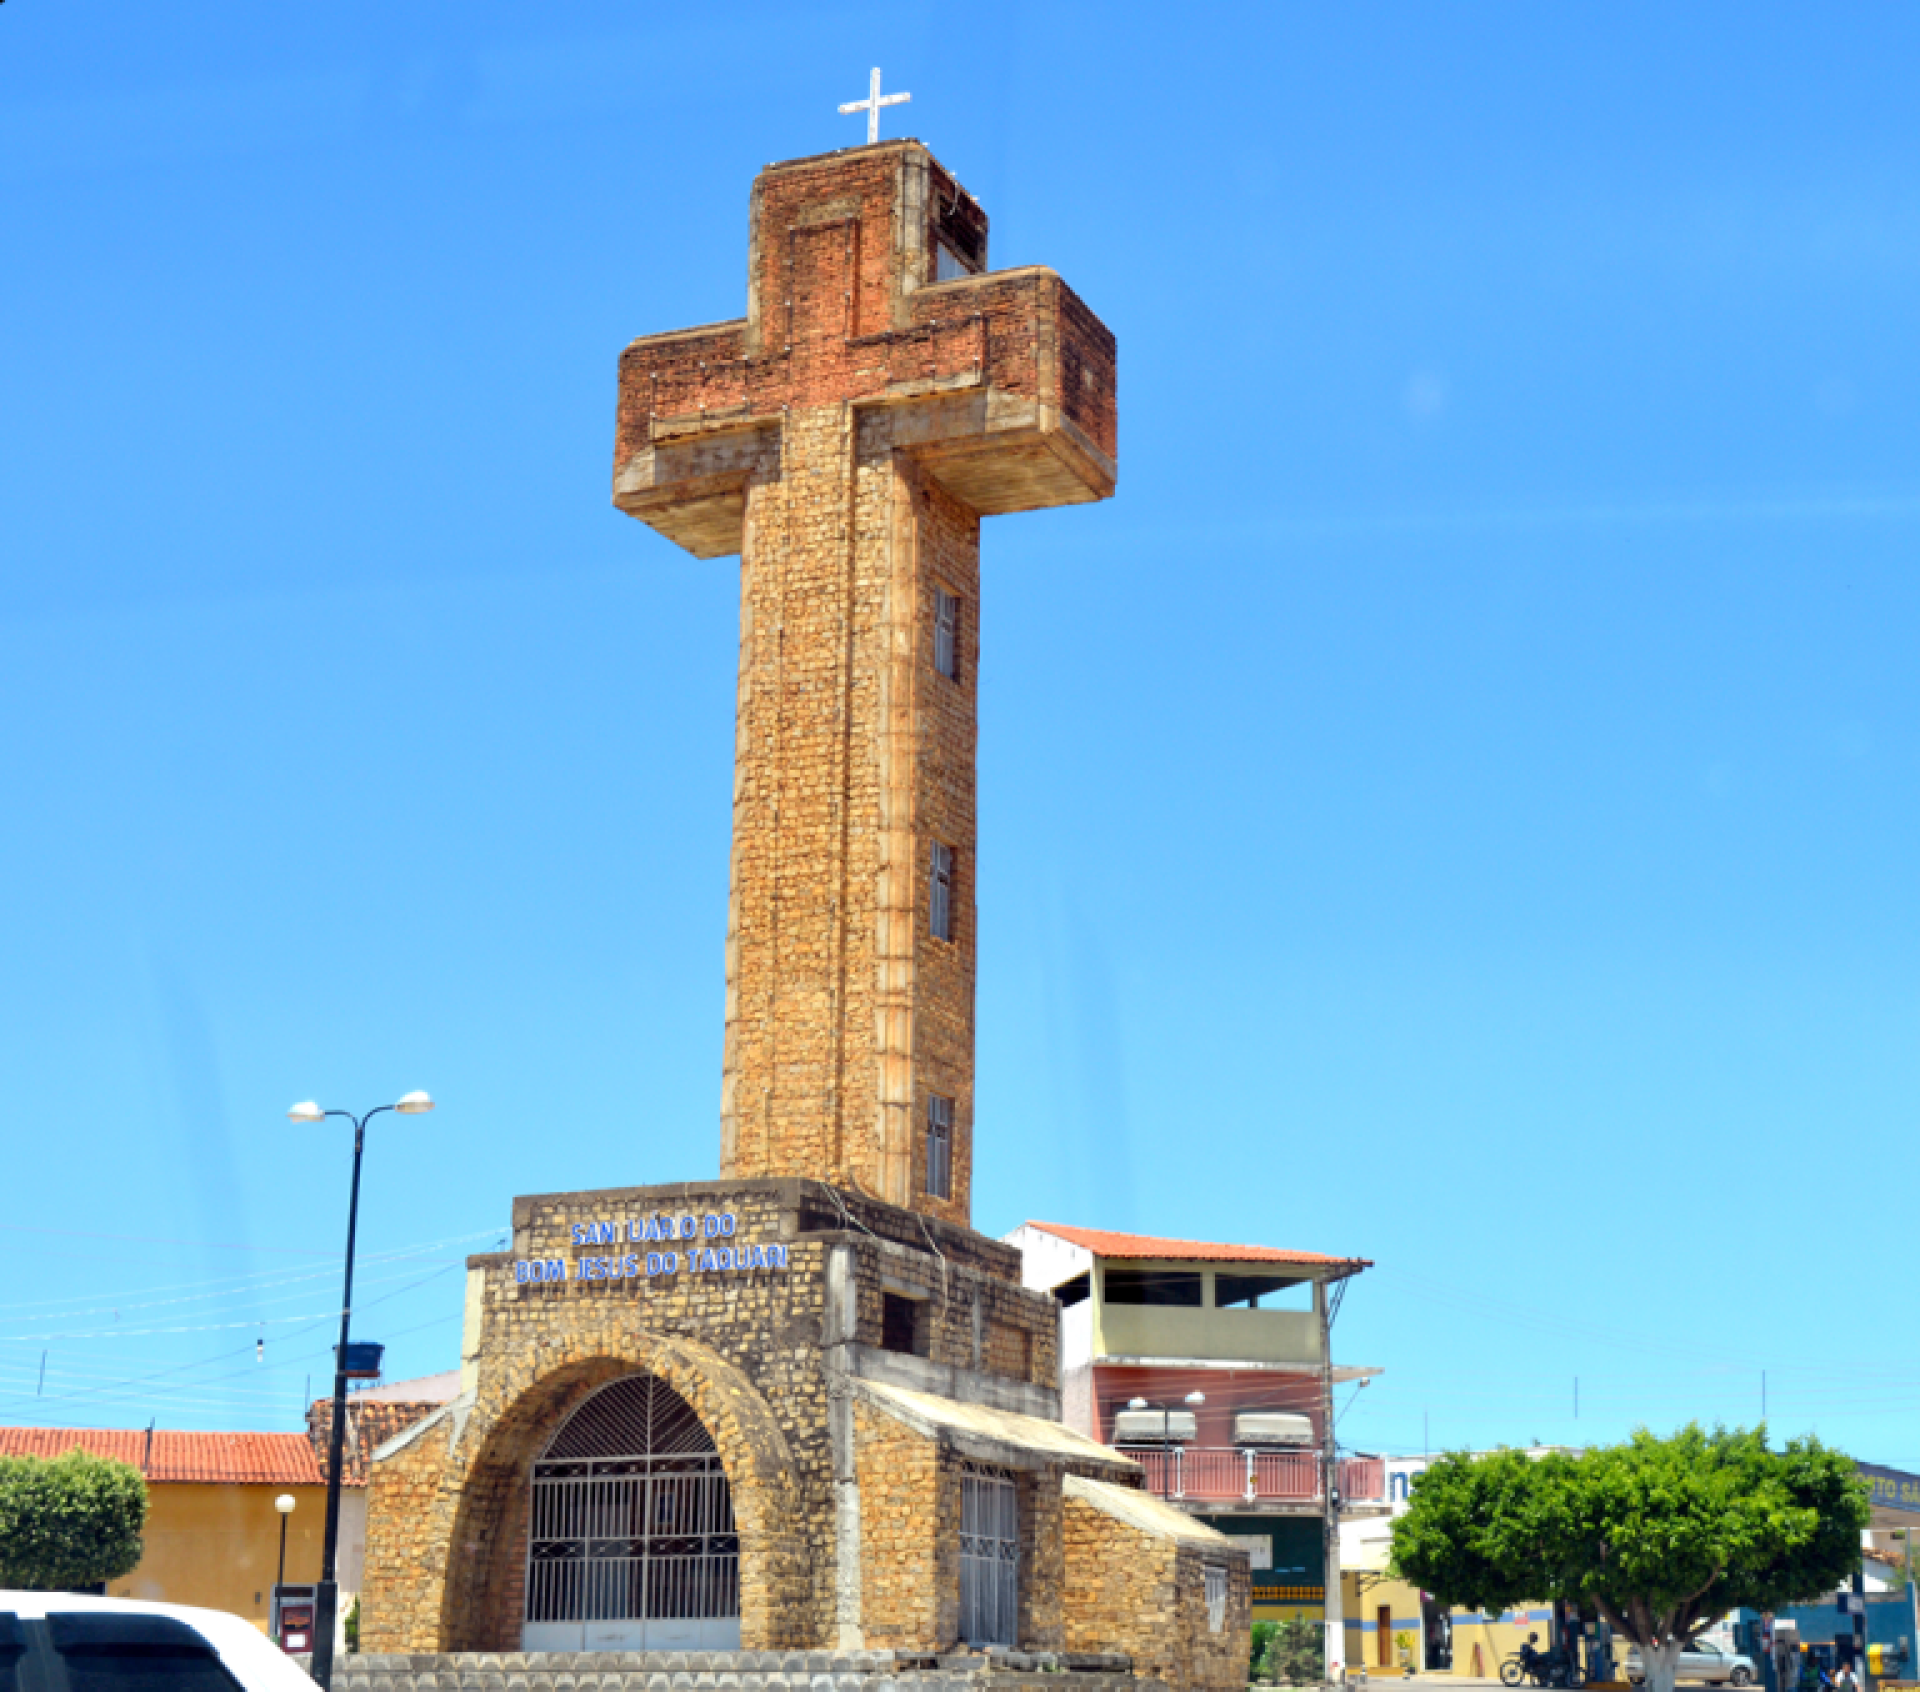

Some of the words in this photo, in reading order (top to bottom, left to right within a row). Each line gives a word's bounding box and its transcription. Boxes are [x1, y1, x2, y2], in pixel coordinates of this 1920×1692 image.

[703, 1213, 736, 1238] DO
[516, 1258, 566, 1283] BOM
[575, 1253, 639, 1281] JESUS
[646, 1251, 677, 1275] DO
